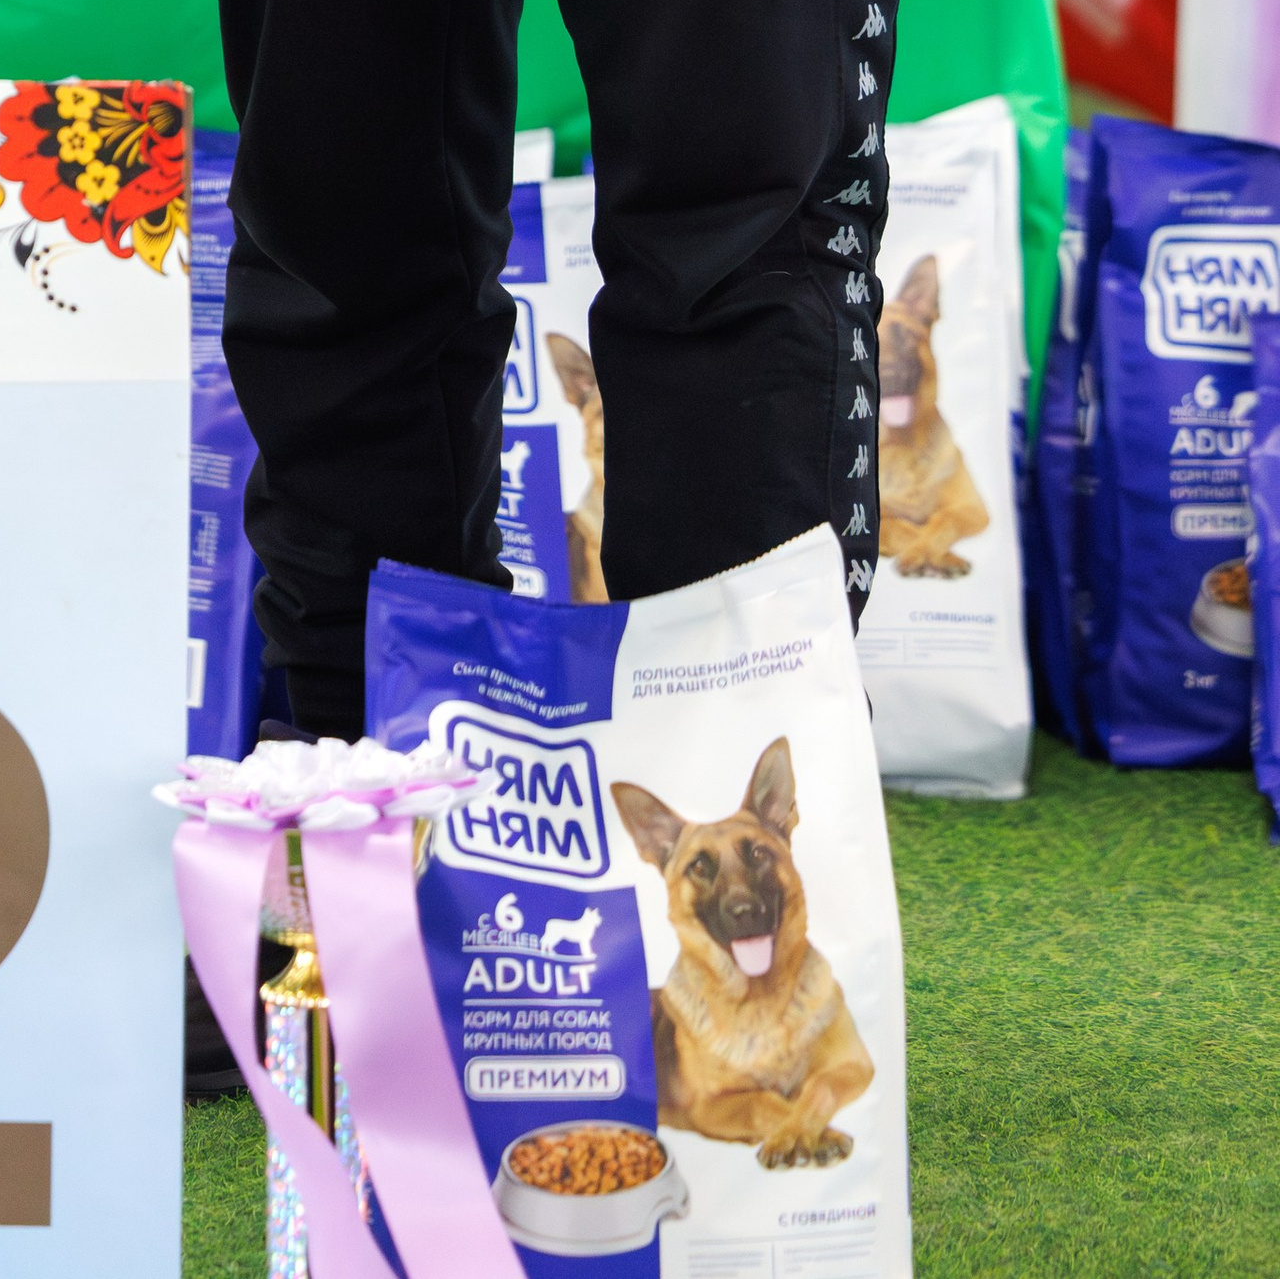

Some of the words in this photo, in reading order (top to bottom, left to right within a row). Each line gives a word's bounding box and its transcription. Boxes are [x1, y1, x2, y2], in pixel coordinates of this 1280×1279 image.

[1165, 255, 1274, 290] НЯМ
[452, 660, 489, 677] Сила
[631, 683, 663, 700] ДЛЯ
[665, 675, 729, 696] ВАШЕГО
[730, 656, 805, 687] ПИТОМЦА
[632, 653, 750, 684] ПОЛНОЦЕННЫЙ
[751, 637, 814, 666] РАЦИОН
[462, 739, 584, 807] НЯМ
[461, 803, 592, 861] НЯМ
[494, 891, 525, 934] 6
[461, 928, 540, 949] МЕСЯЦЕВ
[463, 956, 598, 997] ADULT
[463, 1010, 511, 1029] КОРМ
[512, 1010, 551, 1031] ДЛЯ
[552, 1010, 612, 1029] СОБАК
[463, 1032, 546, 1051] КРУПНЫХ
[548, 1032, 613, 1052] ПОРОД
[477, 1067, 609, 1091] ПРЕМИУМ
